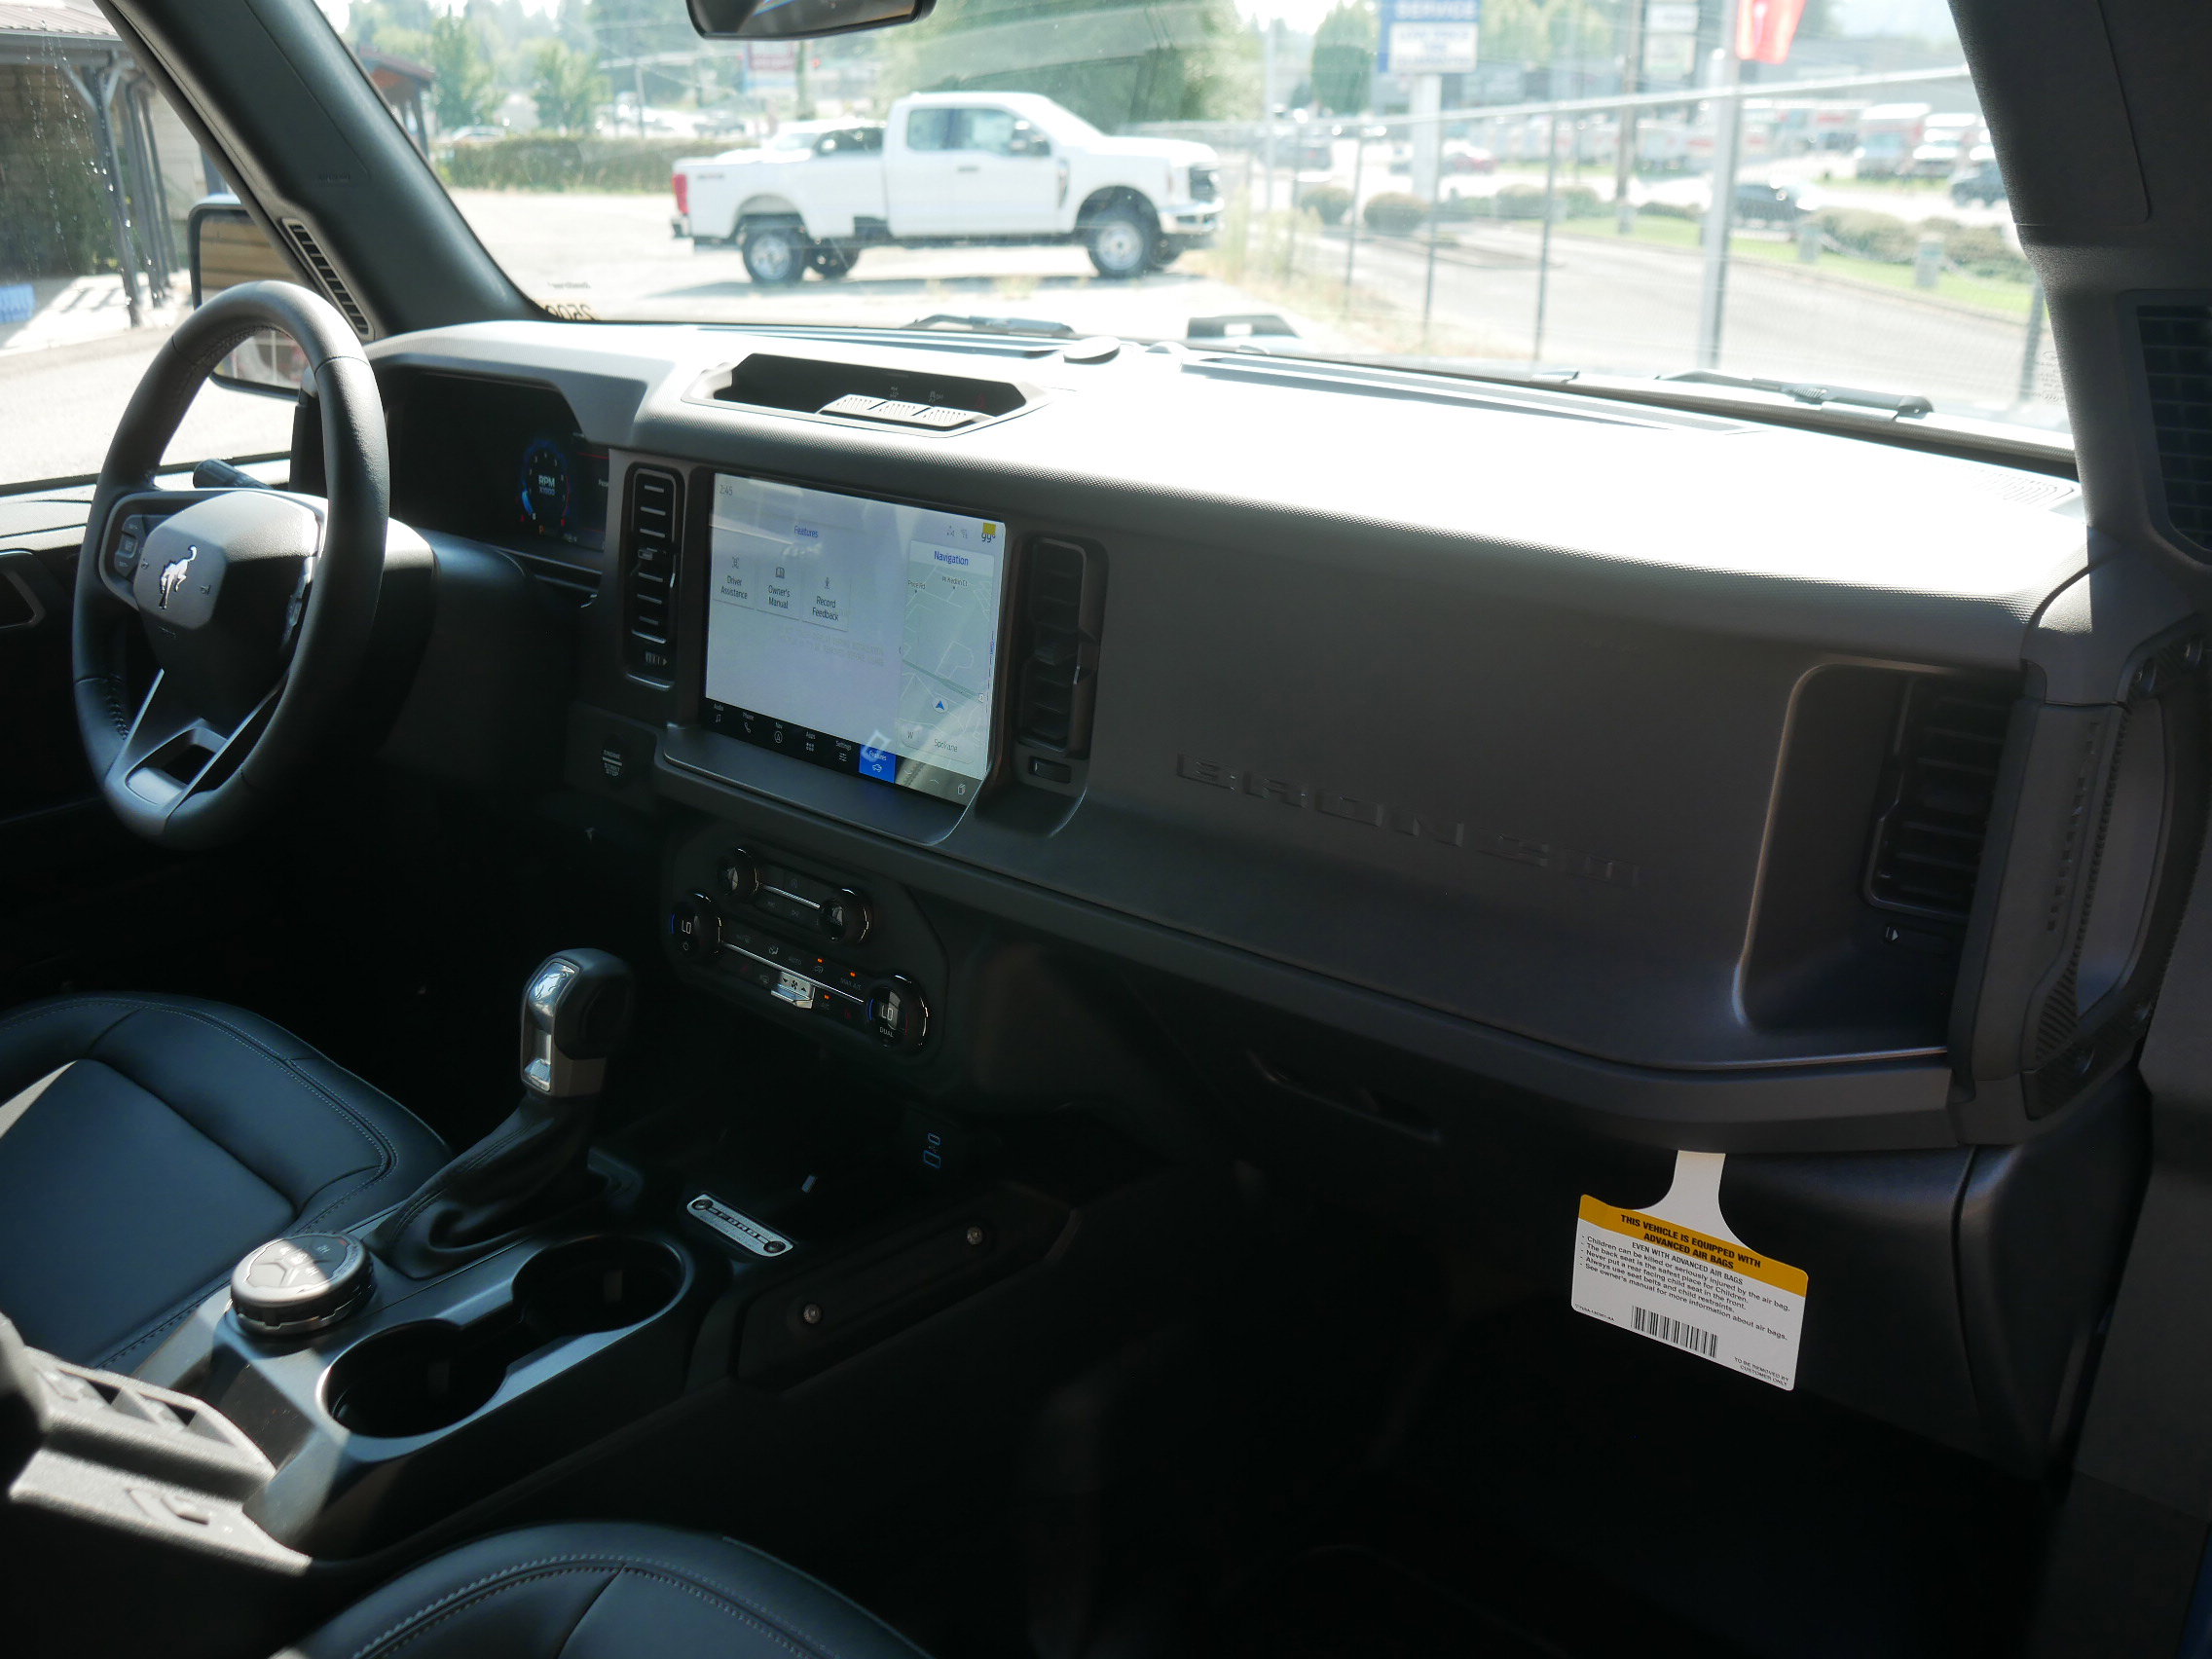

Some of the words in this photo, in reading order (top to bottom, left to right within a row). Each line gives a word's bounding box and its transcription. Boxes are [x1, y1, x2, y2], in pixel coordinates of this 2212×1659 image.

[793, 525, 819, 538] Features
[934, 550, 969, 567] Navigation
[726, 574, 742, 586] Driver
[720, 585, 748, 600] Assistance
[768, 584, 791, 597] Owner's
[768, 597, 789, 609] Manual
[816, 595, 836, 608] Record
[812, 607, 839, 621] Feedback
[879, 1026, 894, 1038] DUAL
[1620, 1214, 1641, 1227] THIS
[1642, 1221, 1679, 1239] VEHICLE
[1680, 1233, 1690, 1242] IS
[1692, 1238, 1735, 1259] EQUIPPED
[1737, 1253, 1761, 1269] WITH
[1643, 1232, 1690, 1254] ADVANCED
[1692, 1249, 1708, 1260] AIR
[1710, 1254, 1735, 1270] BAGS
[1632, 1241, 1650, 1253] EVEN
[1651, 1247, 1670, 1259] WITH
[1671, 1254, 1709, 1272] ADVANCED
[1710, 1269, 1722, 1277] AIR
[1723, 1272, 1744, 1285] BAGS
[1586, 1249, 1606, 1262] Never
[1607, 1257, 1620, 1267] put
[1627, 1264, 1642, 1272] rear
[1643, 1268, 1666, 1282] facing
[1667, 1275, 1685, 1287] child
[1686, 1284, 1703, 1294] seat
[1713, 1292, 1725, 1301] the
[1726, 1298, 1747, 1310] front.
[1587, 1242, 1600, 1251] The
[1601, 1247, 1618, 1259] back
[1619, 1254, 1636, 1264] seat
[1644, 1262, 1657, 1271] the
[1658, 1266, 1680, 1279] safest
[1681, 1274, 1702, 1287] place
[1703, 1281, 1714, 1290] for
[1714, 1286, 1749, 1304] Children.
[1587, 1235, 1617, 1251] Children
[1618, 1246, 1632, 1255] can
[1633, 1250, 1642, 1259] be
[1643, 1253, 1664, 1266] killed
[1675, 1266, 1708, 1282] seriously
[1710, 1276, 1736, 1291] injured
[1737, 1286, 1747, 1297] by
[1749, 1291, 1760, 1301] the
[1761, 1296, 1773, 1305] air
[1774, 1300, 1790, 1312] bag.
[1585, 1256, 1611, 1271] Always
[1627, 1271, 1642, 1280] seat
[1643, 1275, 1661, 1286] belts
[1663, 1281, 1677, 1292] and
[1677, 1287, 1697, 1299] child
[1698, 1295, 1735, 1312] restraints.
[1585, 1263, 1599, 1272] See
[1600, 1269, 1627, 1282] owner's
[1629, 1279, 1655, 1292] manual
[1656, 1286, 1668, 1295] for
[1669, 1293, 1688, 1304] more
[1688, 1298, 1731, 1319] information
[1732, 1315, 1754, 1328] about
[1767, 1327, 1788, 1341] bags.
